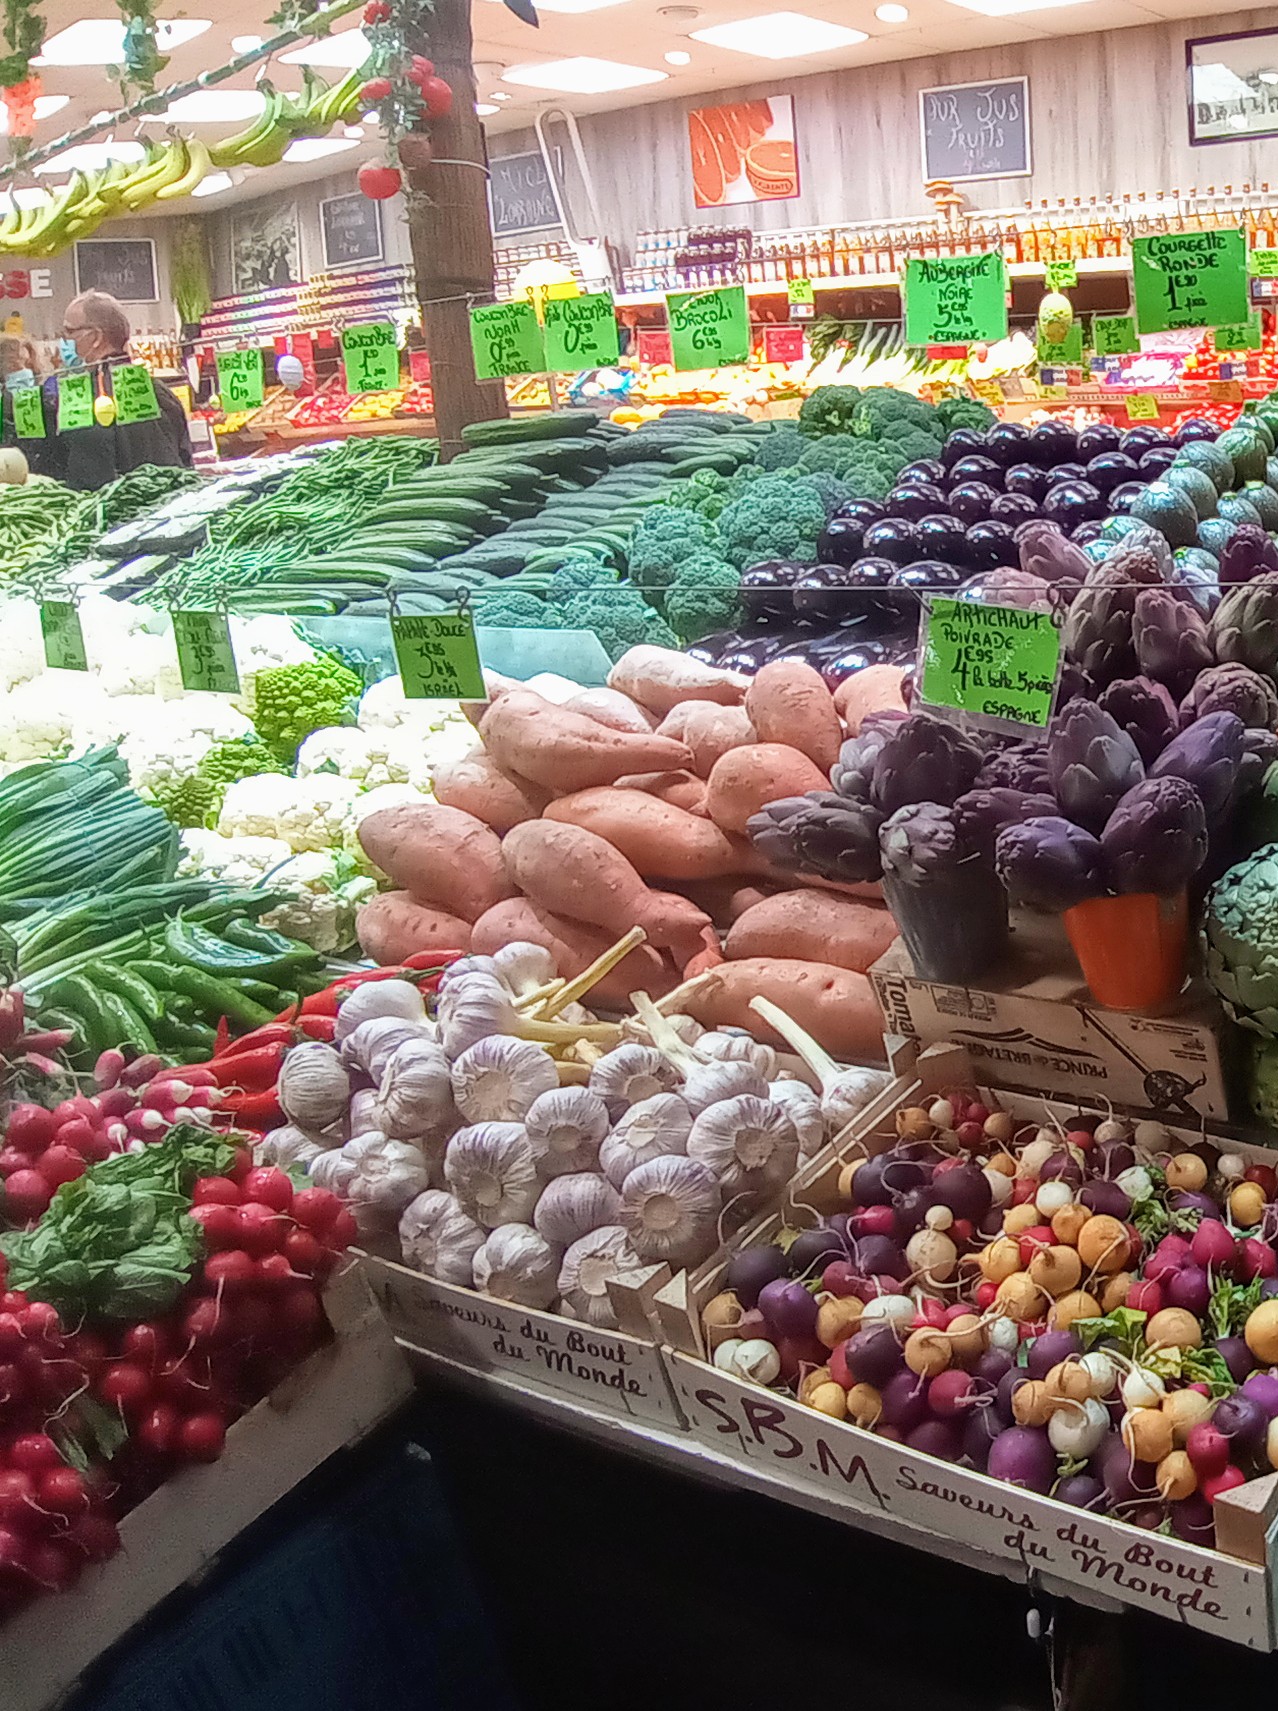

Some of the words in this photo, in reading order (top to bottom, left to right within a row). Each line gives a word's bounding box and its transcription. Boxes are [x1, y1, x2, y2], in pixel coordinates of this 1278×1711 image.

[976, 87, 1020, 122] JUS
[948, 119, 1005, 150] FRUITS
[1147, 231, 1228, 256] COURGETTE
[918, 254, 991, 284] AUBERGINE
[1157, 253, 1220, 273] RONDE
[938, 283, 974, 303] NOIRE
[484, 320, 521, 340] NOAH
[670, 302, 733, 331] BROCOLI
[946, 601, 1046, 631] ARTICHAUT
[940, 622, 1015, 650] POIVRADE
[982, 700, 1042, 725] ESPAGNE
[1051, 1057, 1108, 1079] PRINCE
[519, 1319, 557, 1346] du
[566, 1330, 632, 1366] Bout
[491, 1333, 530, 1362] du
[536, 1344, 648, 1398] Monde
[895, 1465, 1041, 1532] Saveurs
[1056, 1521, 1107, 1553] du
[1124, 1541, 1218, 1589] Bout
[1003, 1531, 1056, 1562] du
[1071, 1548, 1229, 1621] Monde
